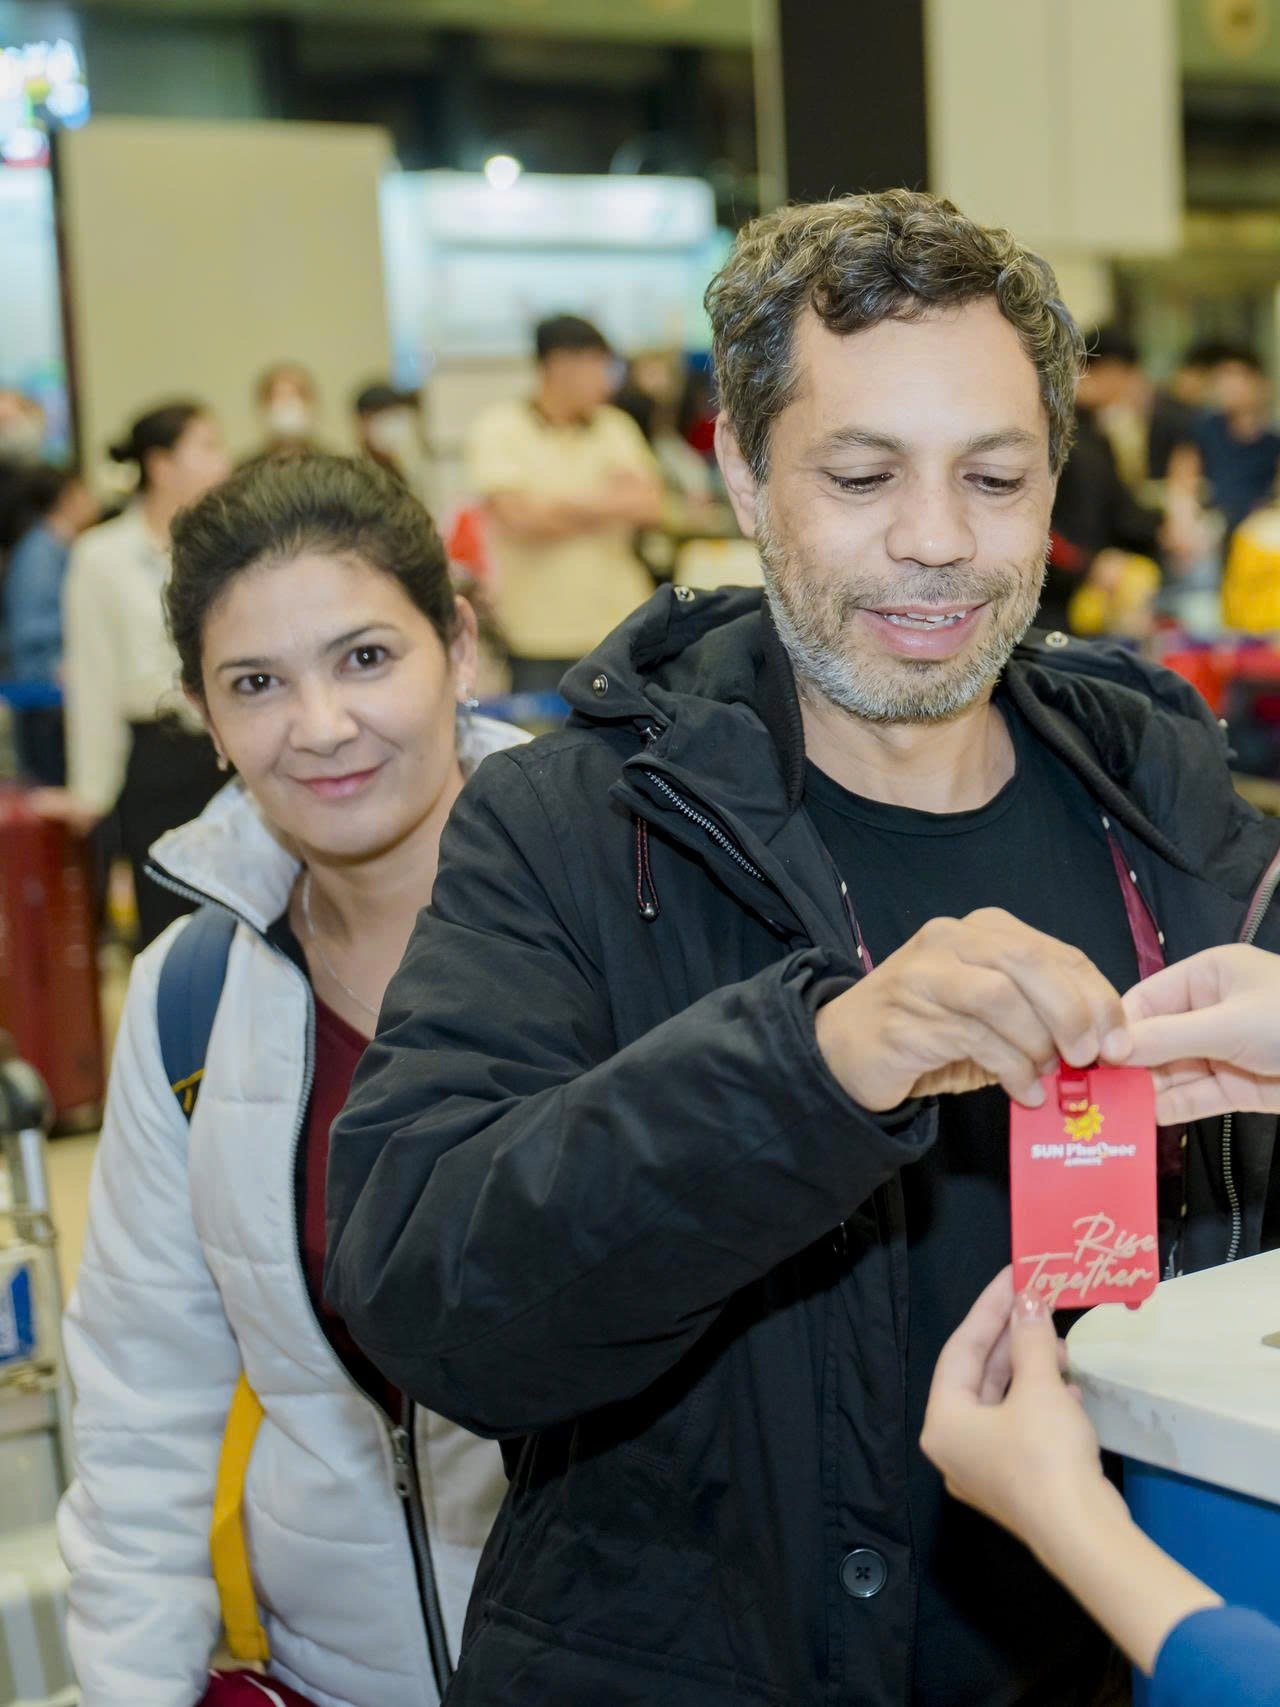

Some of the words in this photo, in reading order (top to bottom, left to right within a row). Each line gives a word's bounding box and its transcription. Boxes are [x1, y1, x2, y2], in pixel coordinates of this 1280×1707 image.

[1031, 1143, 1064, 1159] SUN
[1072, 1212, 1156, 1264] Rise
[1018, 1252, 1154, 1306] Together
